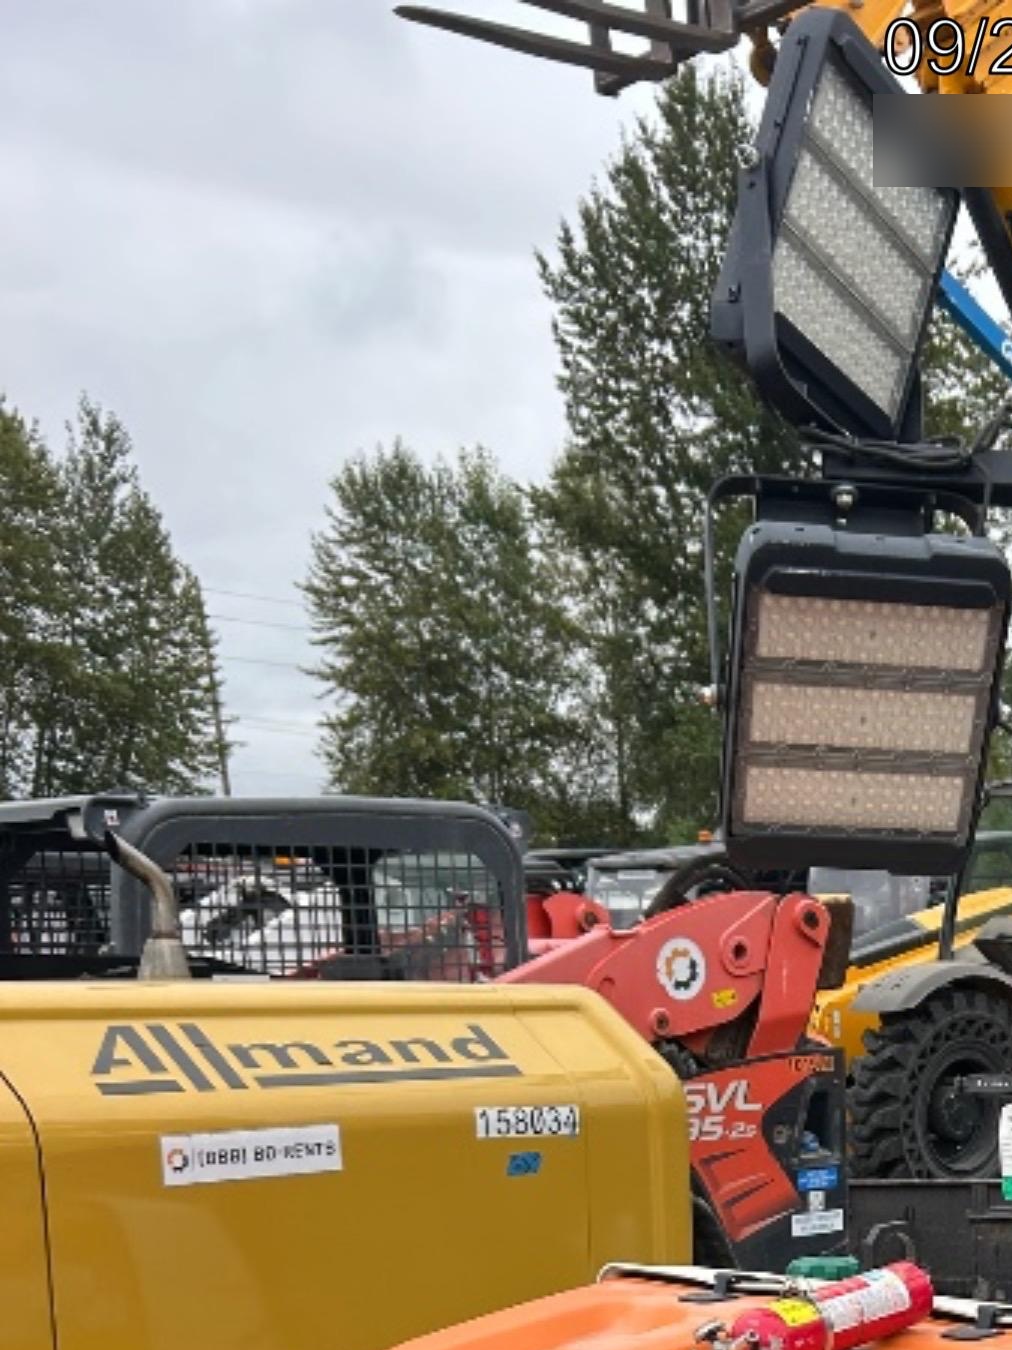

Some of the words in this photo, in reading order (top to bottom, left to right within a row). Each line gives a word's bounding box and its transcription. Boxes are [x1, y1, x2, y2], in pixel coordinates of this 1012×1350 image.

[91, 1022, 510, 1092] Allmand
[683, 1080, 763, 1114] SVL
[479, 1107, 577, 1139] 158034
